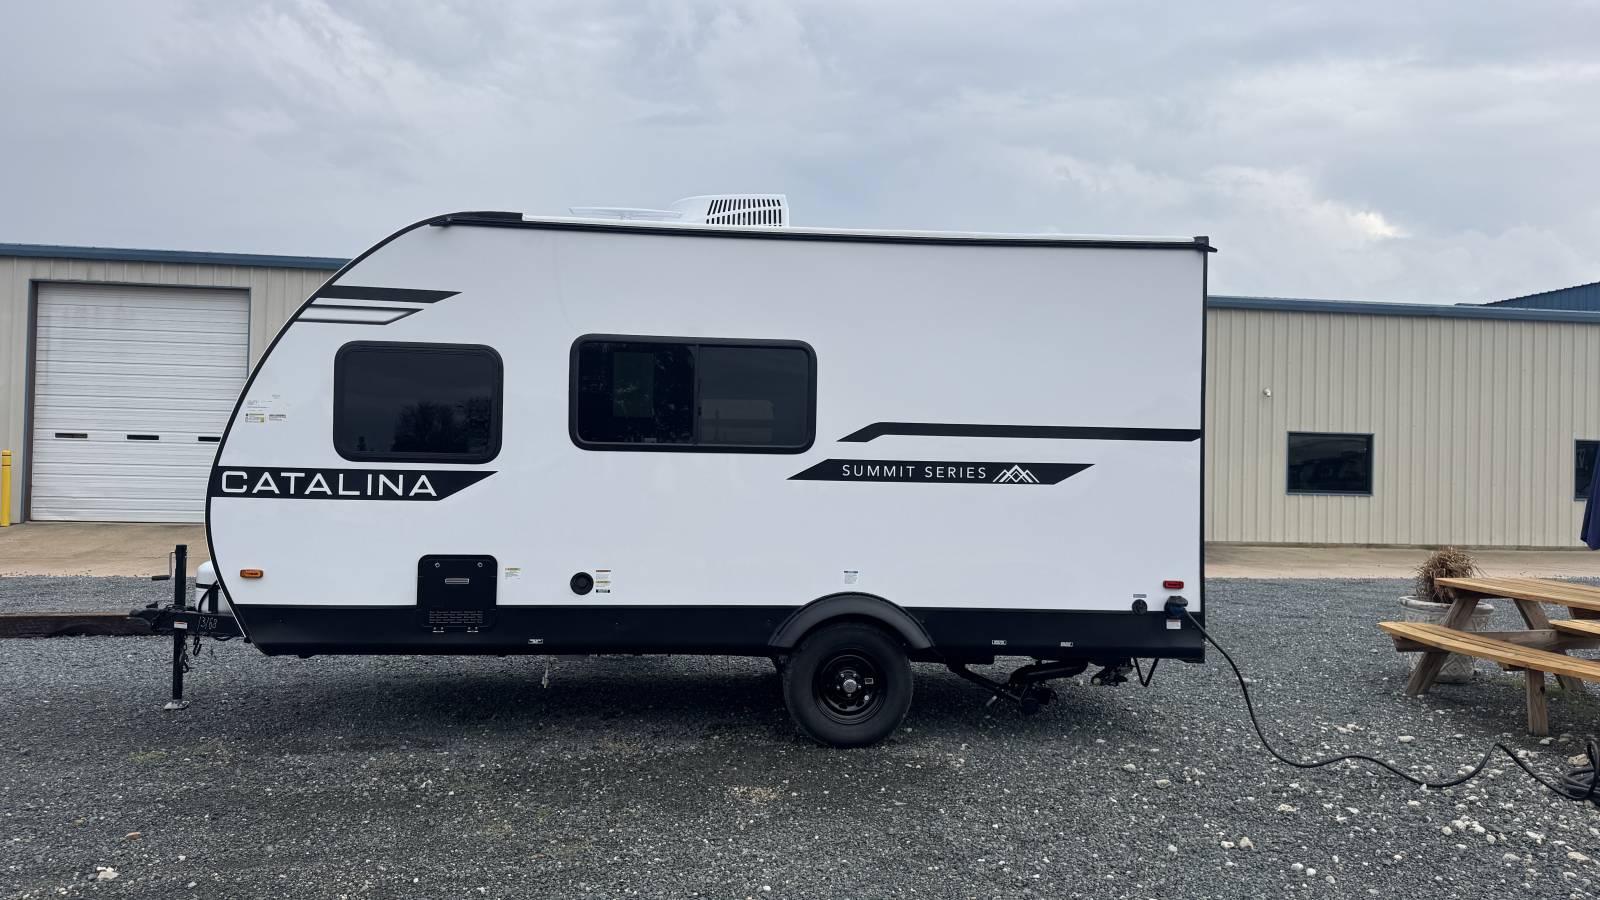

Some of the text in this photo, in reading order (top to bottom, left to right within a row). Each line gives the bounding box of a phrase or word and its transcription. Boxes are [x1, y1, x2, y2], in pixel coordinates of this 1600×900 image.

[842, 464, 987, 479] SUMMIT SERIES
[221, 470, 438, 497] CATALINA
